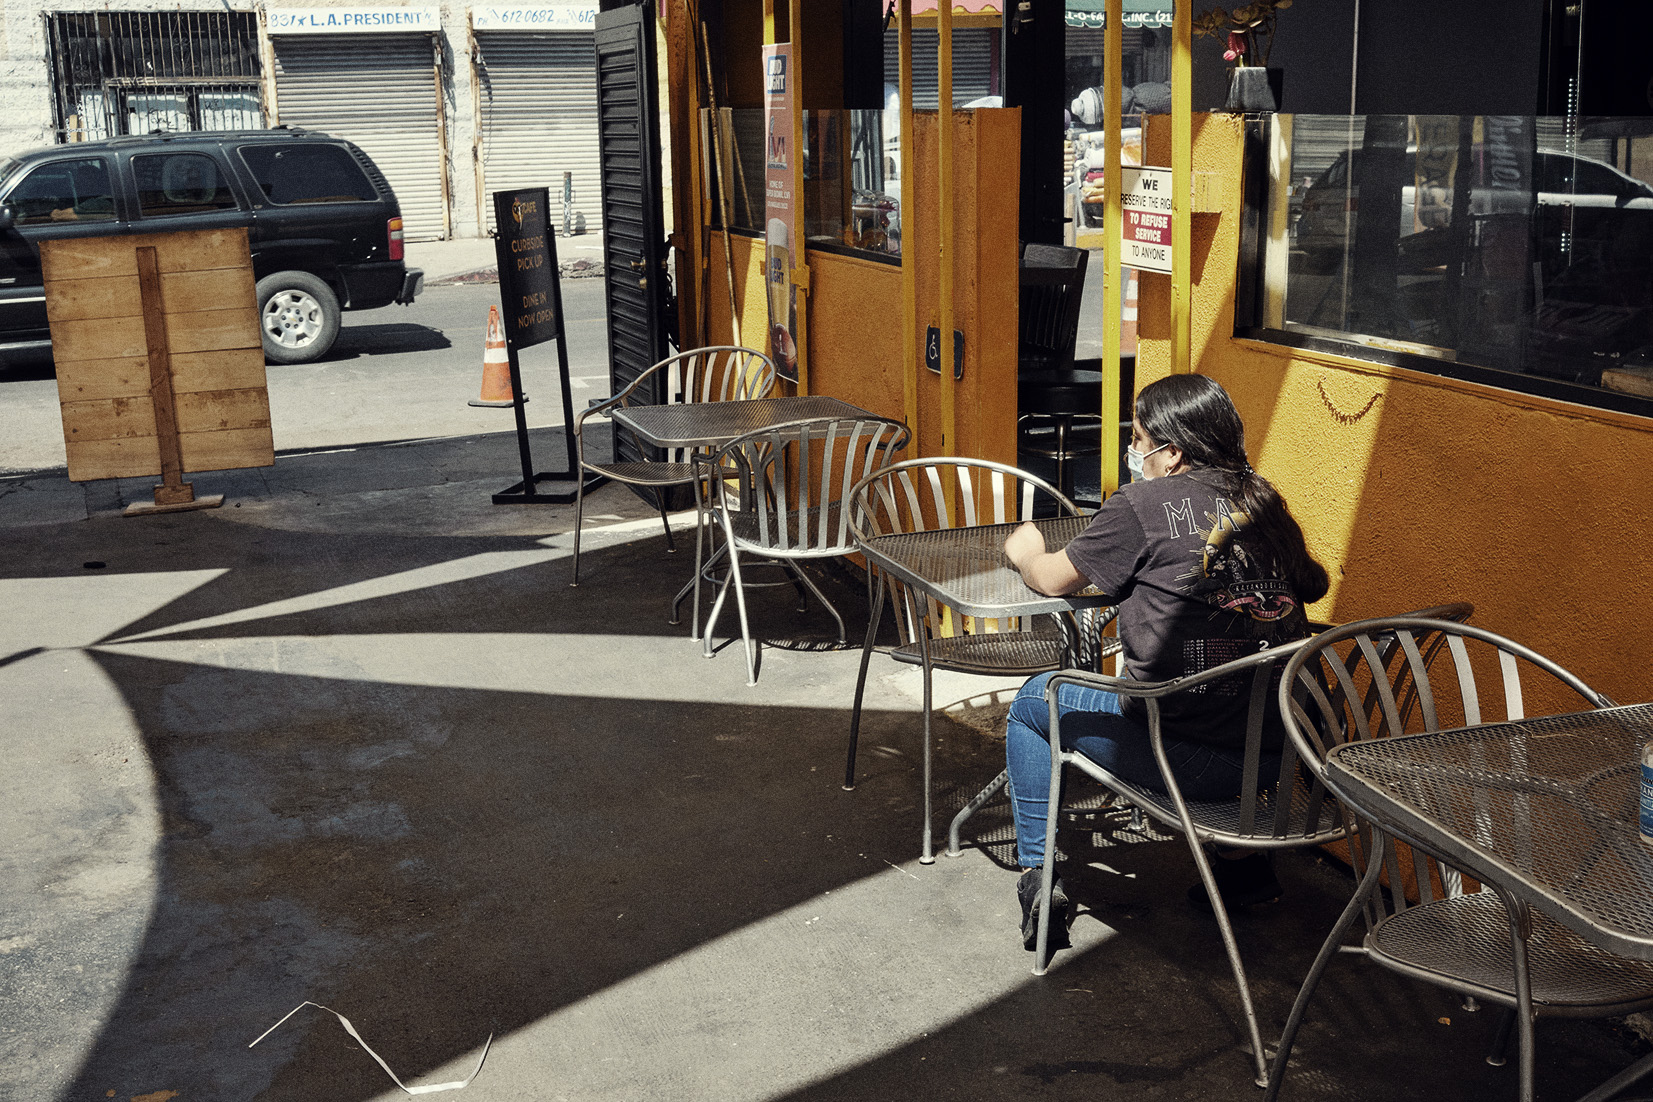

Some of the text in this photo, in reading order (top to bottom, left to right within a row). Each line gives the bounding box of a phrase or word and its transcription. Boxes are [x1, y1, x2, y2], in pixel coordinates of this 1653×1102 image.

[768, 58, 782, 75] BUD
[767, 74, 785, 90] LIGHT
[1142, 178, 1159, 191] WE
[1121, 193, 1147, 207] RESERVE
[1148, 196, 1159, 209] THE
[1130, 212, 1168, 229] TO REFUSE
[1135, 227, 1162, 243] SERVICE
[512, 235, 544, 253] CURBSIDE
[1132, 245, 1166, 261] TO ANYONE
[517, 254, 544, 272] PICK UP
[770, 257, 782, 271] BUD
[523, 291, 547, 308] DINE IN
[518, 309, 554, 329] NOW OPEN
